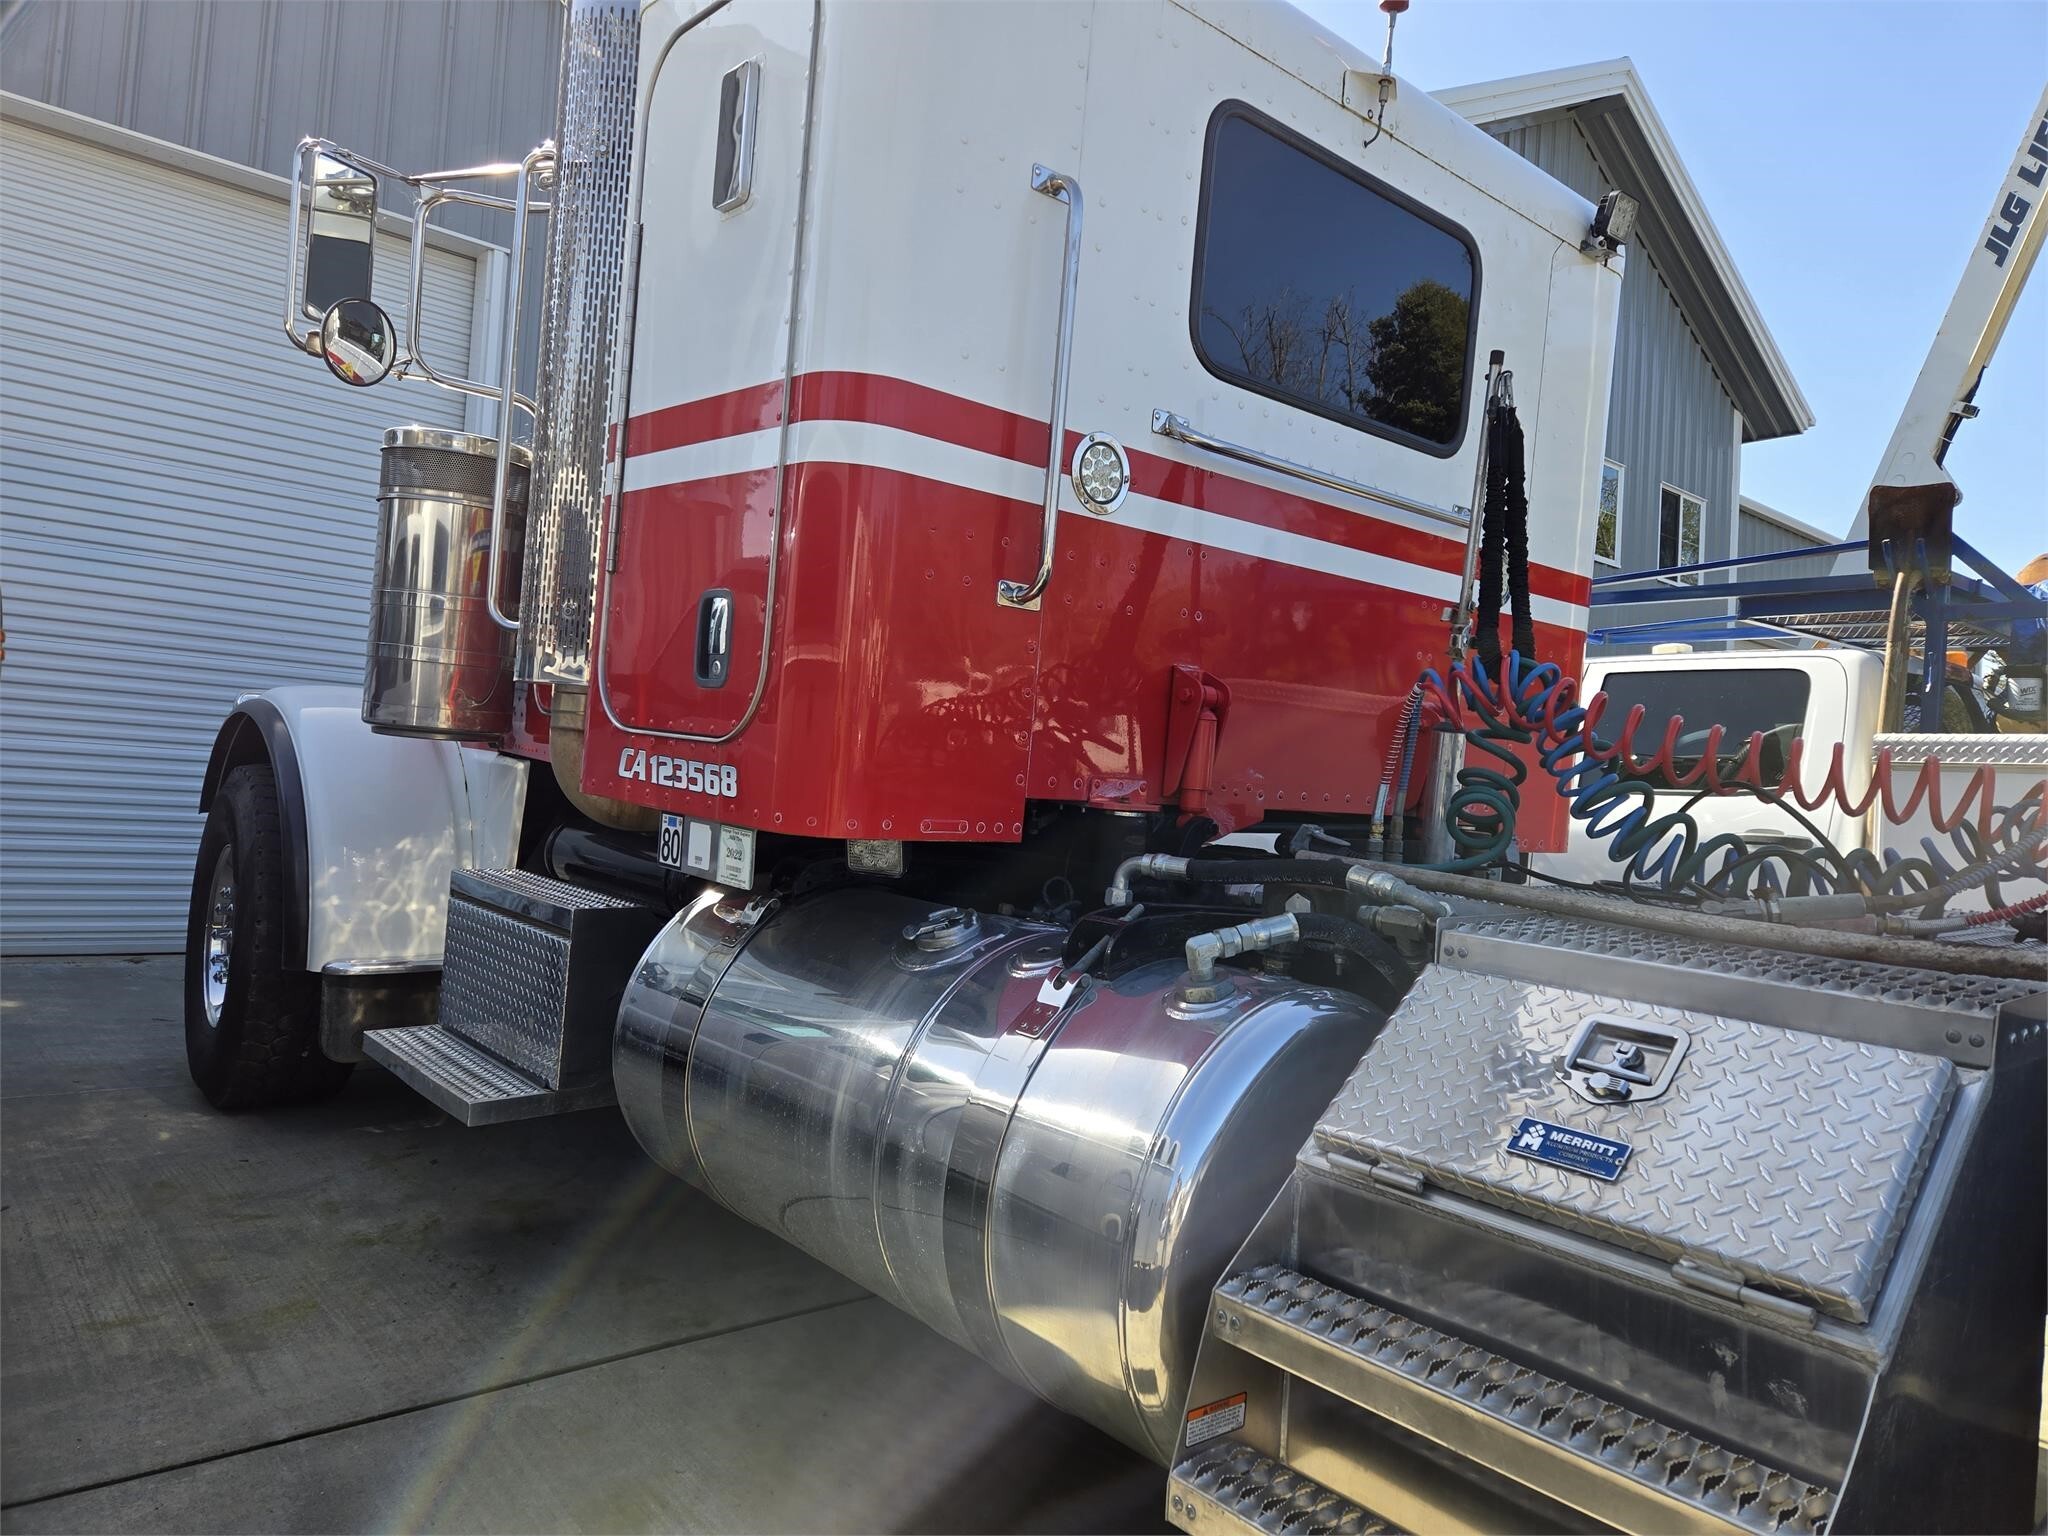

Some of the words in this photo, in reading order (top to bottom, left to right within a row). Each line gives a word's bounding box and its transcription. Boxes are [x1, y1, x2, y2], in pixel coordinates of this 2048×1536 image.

[1984, 191, 2032, 268] JLG
[2016, 108, 2048, 188] LIF
[661, 827, 681, 865] 80
[1549, 1131, 1618, 1156] MERRITT
